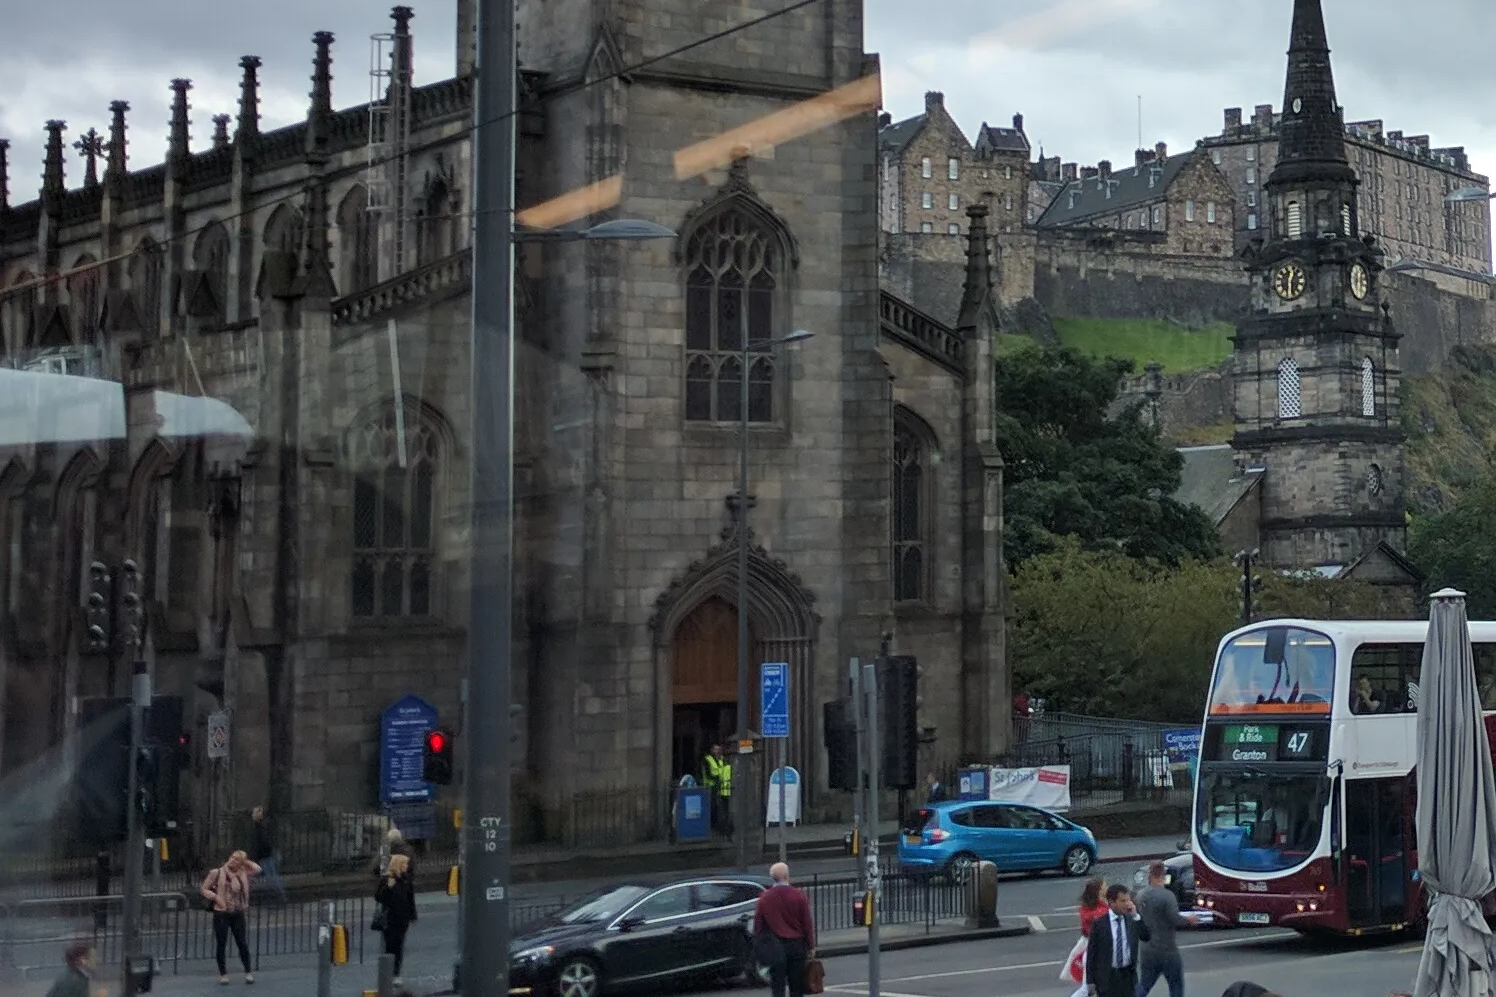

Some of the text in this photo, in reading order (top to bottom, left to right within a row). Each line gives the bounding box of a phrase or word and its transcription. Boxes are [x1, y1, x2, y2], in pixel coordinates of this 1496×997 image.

[1239, 733, 1263, 742] & Ride
[1287, 733, 1309, 753] 47
[1232, 748, 1268, 761] Granton
[480, 817, 501, 827] CTY
[485, 830, 496, 839] 12
[485, 842, 496, 851] 10
